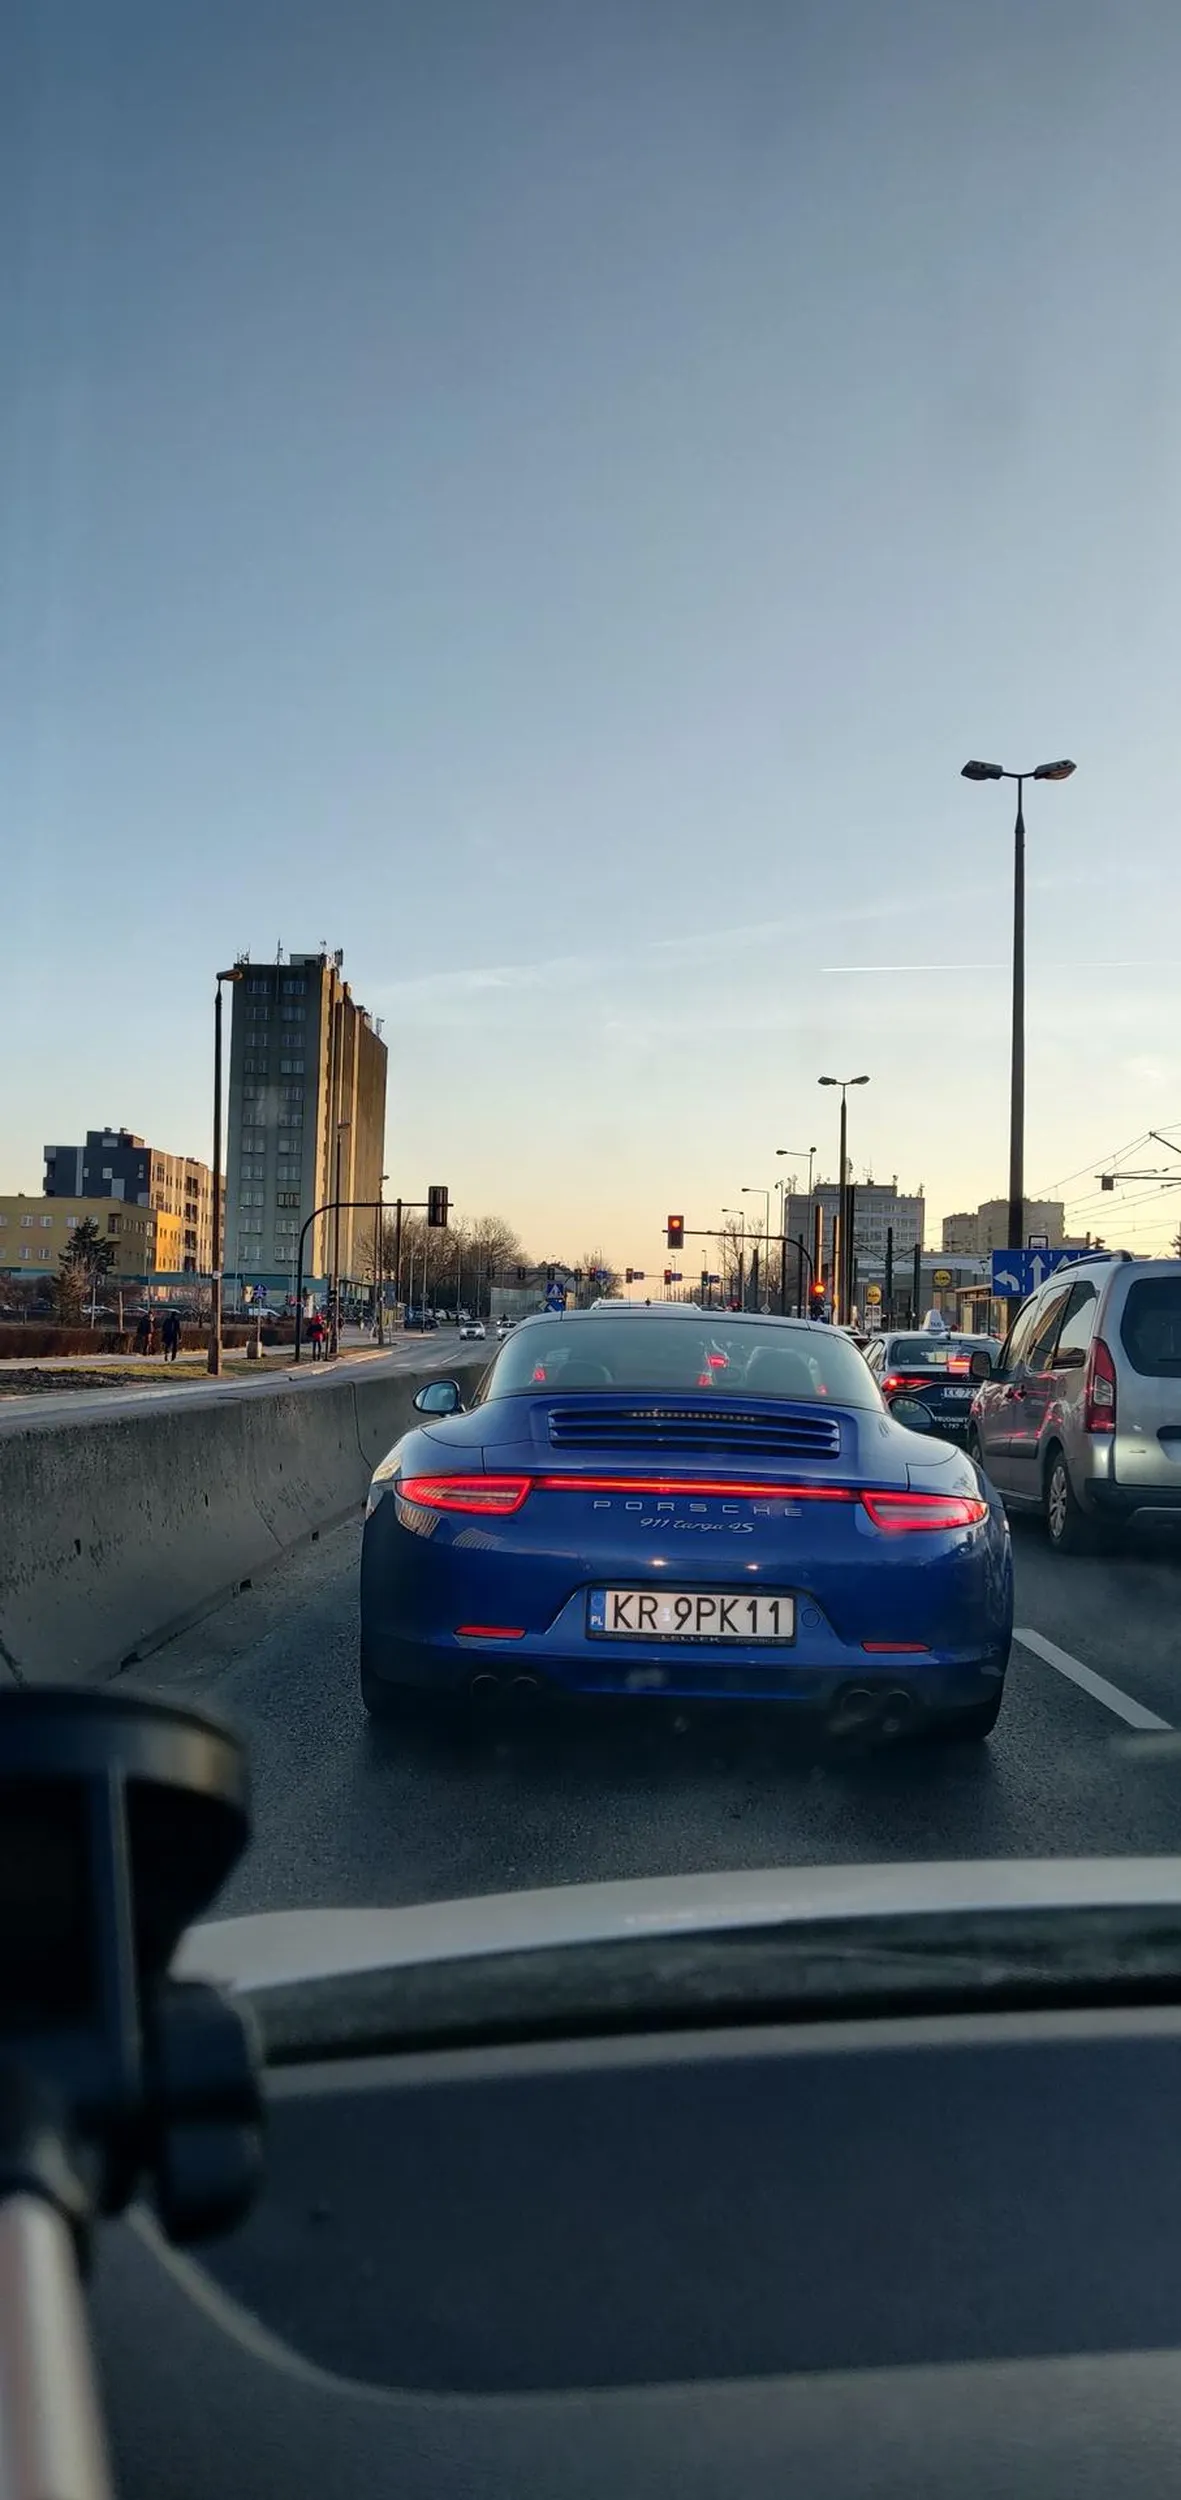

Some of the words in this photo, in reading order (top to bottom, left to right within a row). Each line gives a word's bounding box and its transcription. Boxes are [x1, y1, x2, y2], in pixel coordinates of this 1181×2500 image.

[593, 1500, 803, 1516] PORSCHE
[640, 1517, 670, 1529] 911
[673, 1520, 724, 1532] targa
[728, 1522, 755, 1534] 4S
[590, 1615, 604, 1626] PL
[613, 1594, 658, 1630] KR
[674, 1597, 780, 1635] 9PK11
